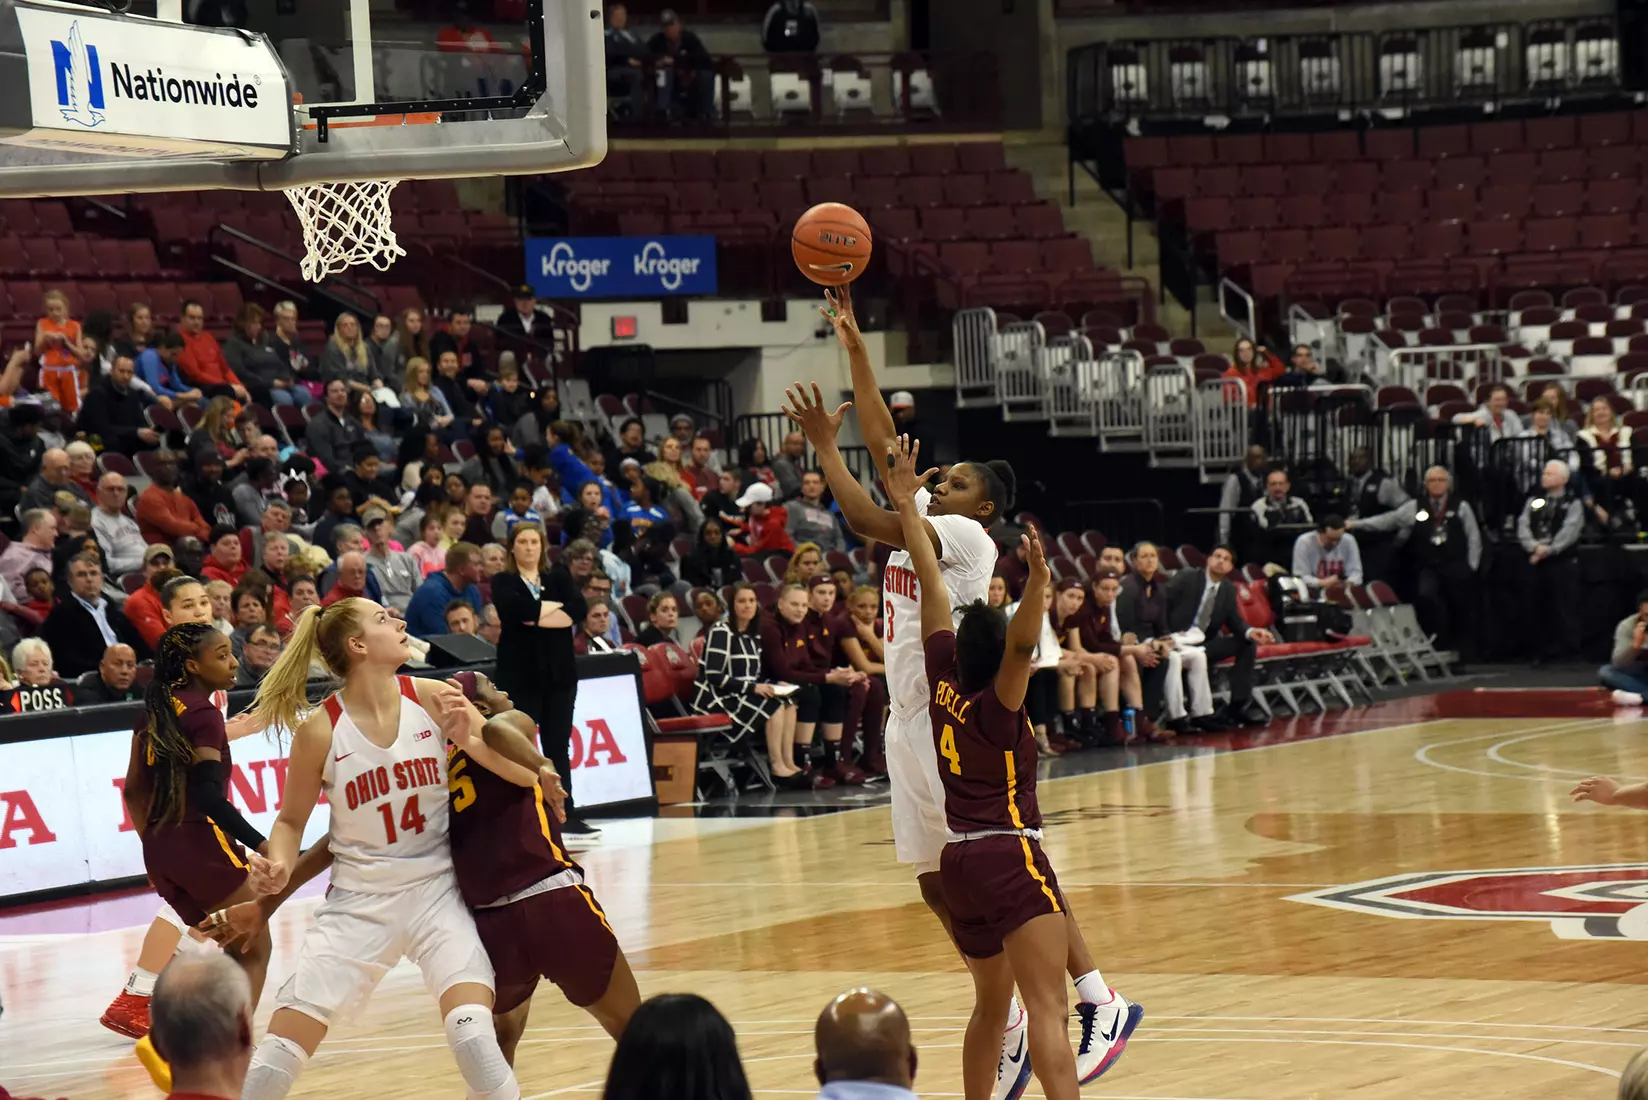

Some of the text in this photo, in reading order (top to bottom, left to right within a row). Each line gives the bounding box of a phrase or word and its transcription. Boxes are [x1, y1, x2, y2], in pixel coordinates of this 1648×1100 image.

[110, 62, 258, 108] Nationwide
[541, 242, 611, 291] Kroger
[633, 241, 701, 290] Kroger
[885, 565, 918, 602] STATE
[886, 600, 895, 643] 3
[939, 724, 962, 775] 4
[345, 766, 390, 811] OHIO
[393, 757, 441, 790] STATE
[377, 794, 426, 845] 14
